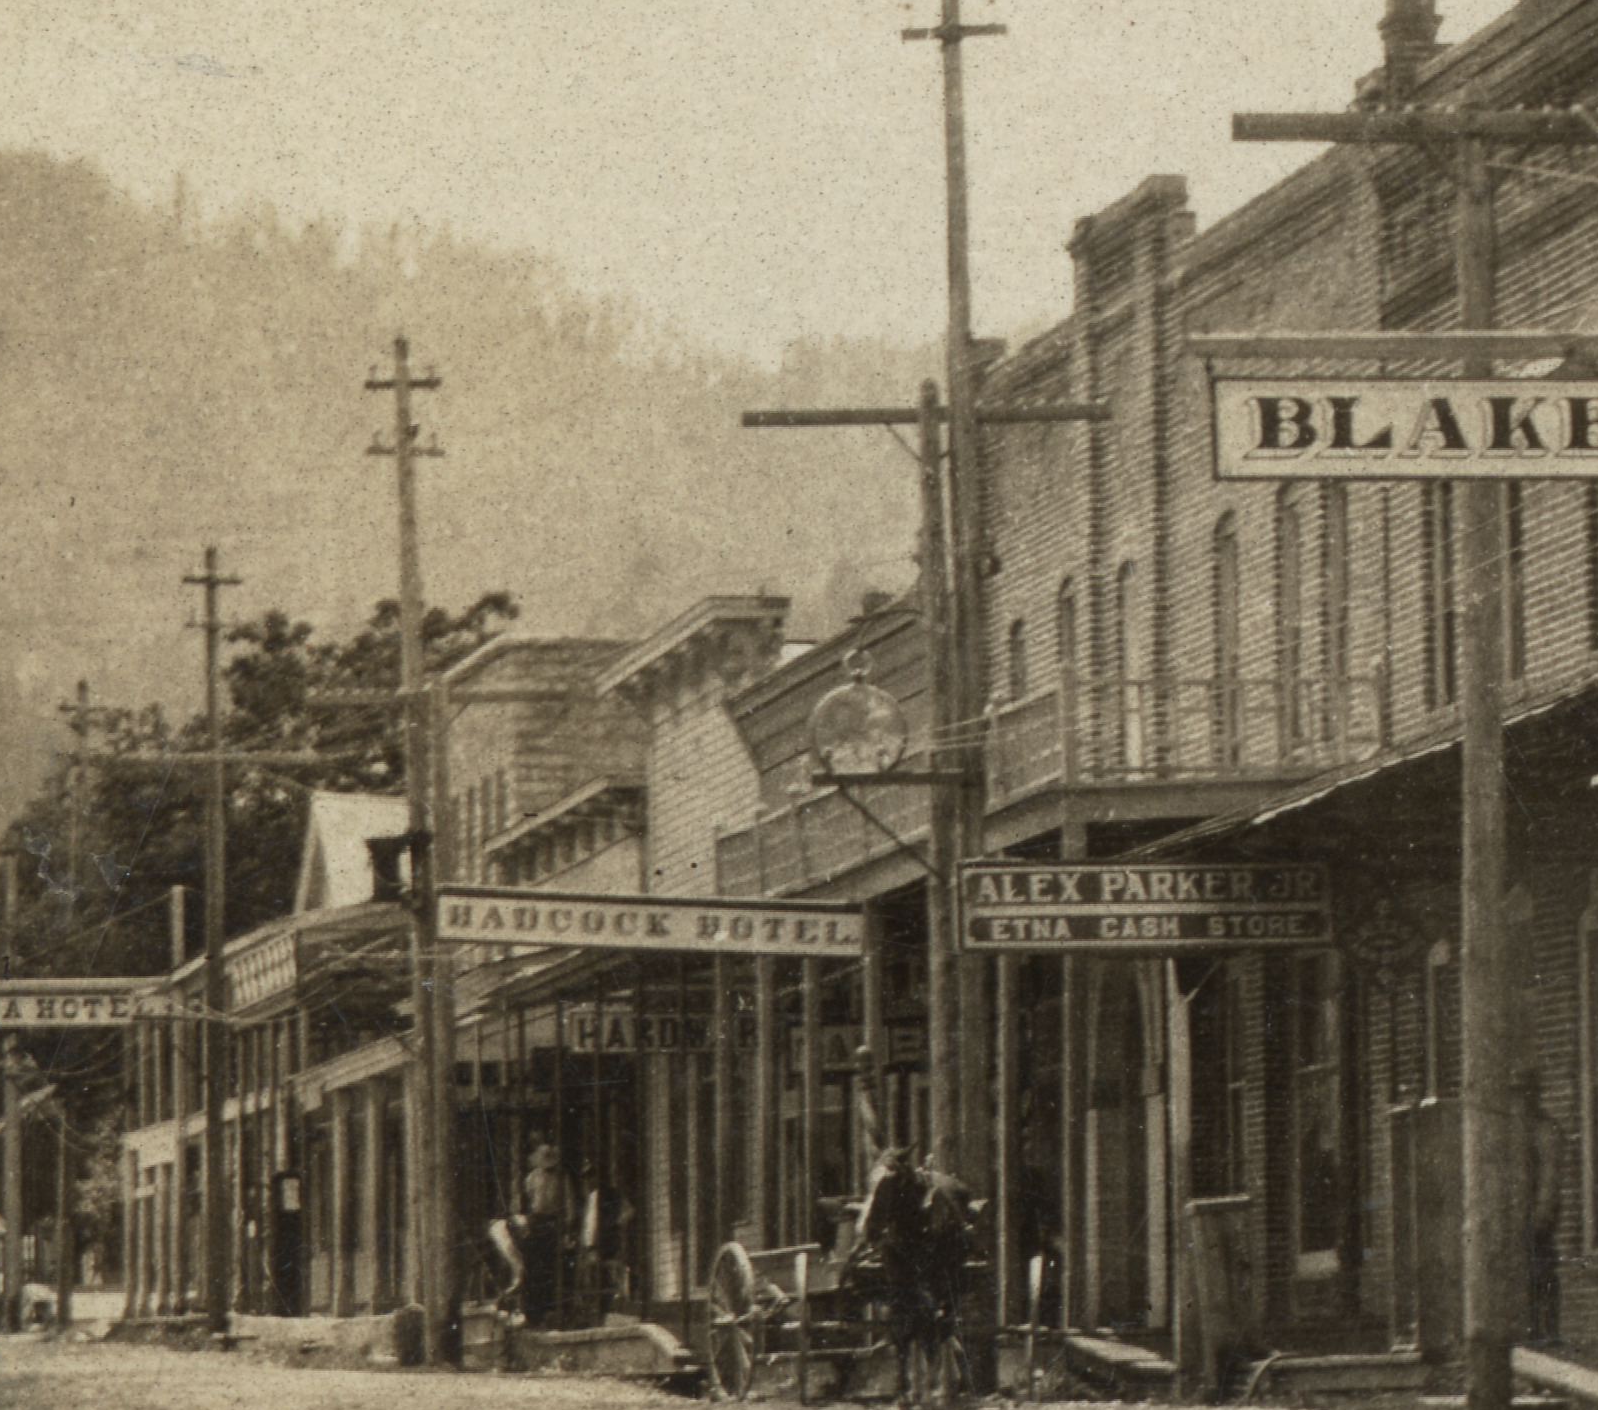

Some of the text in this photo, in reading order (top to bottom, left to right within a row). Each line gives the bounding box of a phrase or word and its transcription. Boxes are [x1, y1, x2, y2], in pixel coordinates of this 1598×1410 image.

[976, 874, 1083, 903] ALEX
[1101, 872, 1254, 902] PARKER
[991, 917, 1072, 940] ETNA
[1101, 916, 1180, 939] CASH
